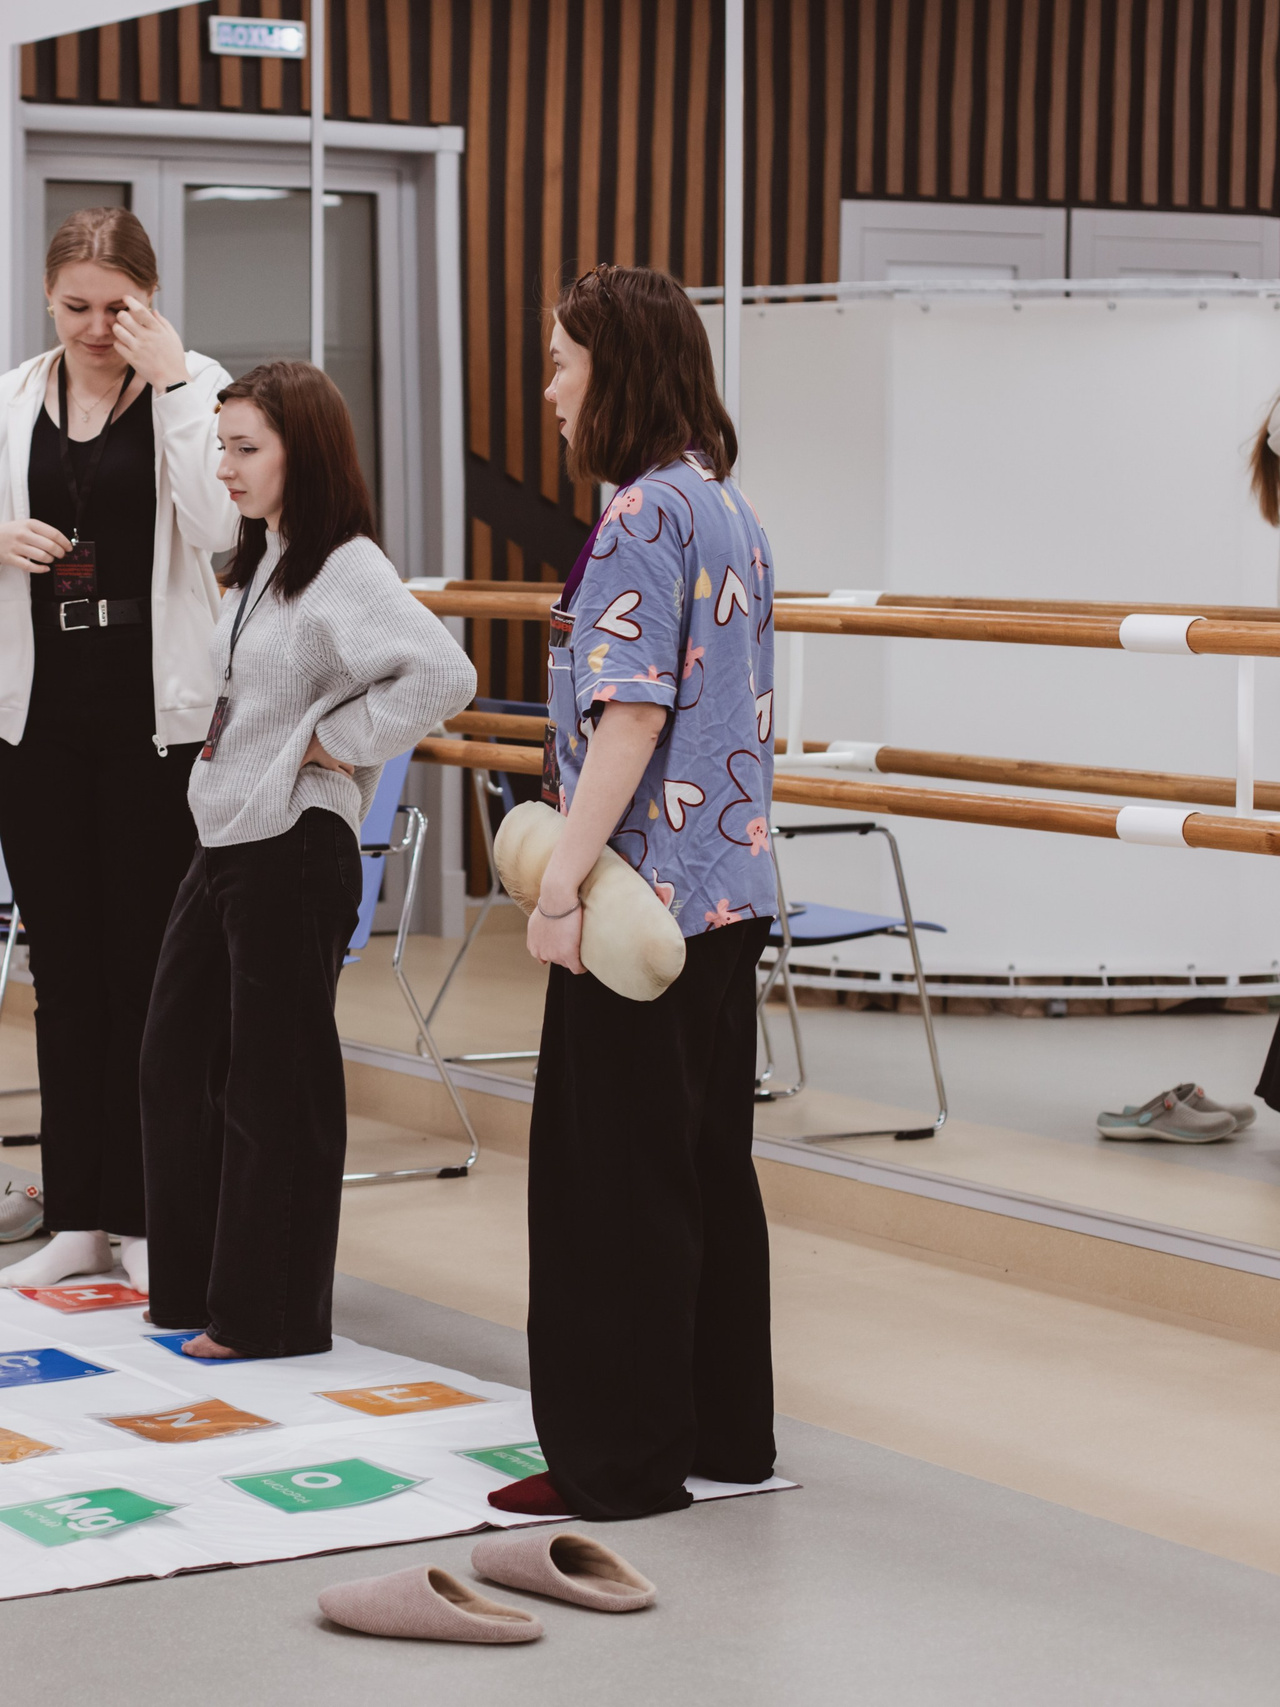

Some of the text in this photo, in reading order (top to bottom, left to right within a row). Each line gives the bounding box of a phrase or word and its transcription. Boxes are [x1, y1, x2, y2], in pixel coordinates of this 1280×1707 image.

[371, 1387, 432, 1404] Li
[154, 1411, 212, 1428] N
[43, 1496, 126, 1532] Mg
